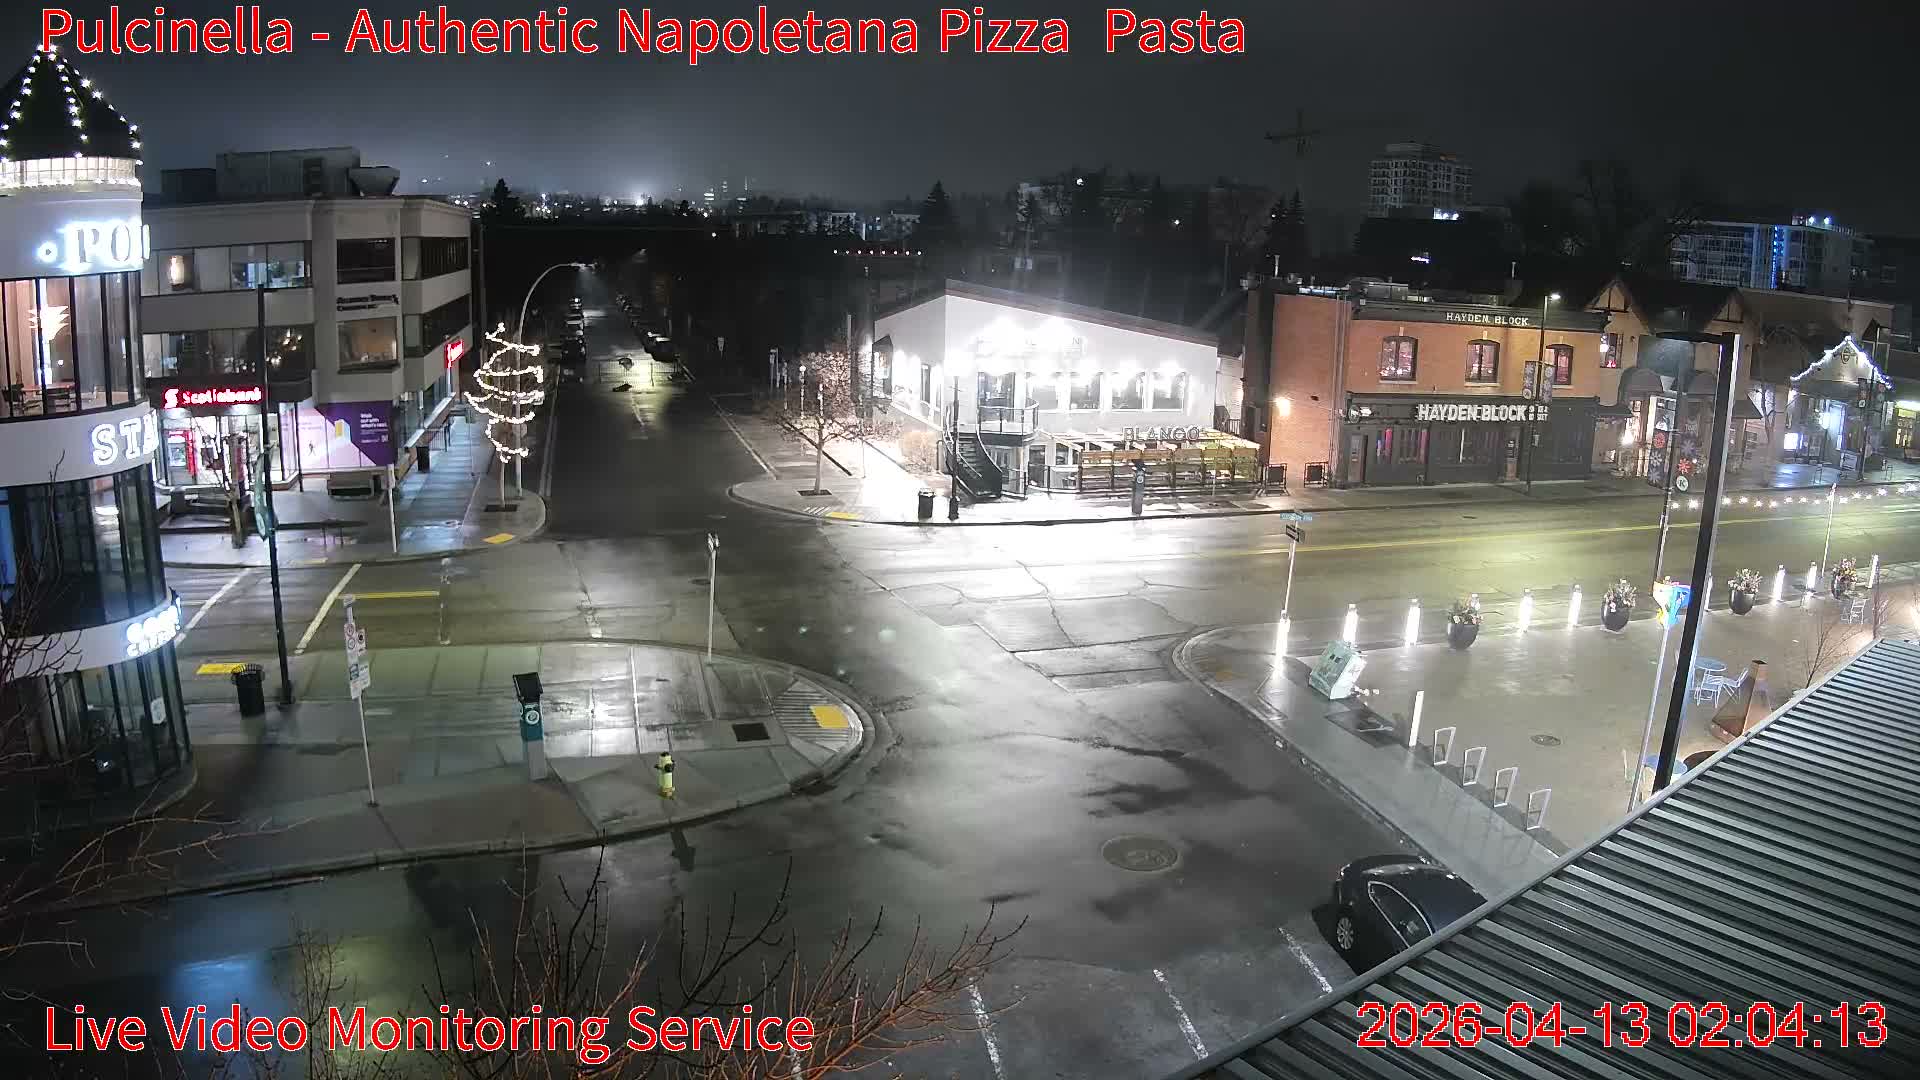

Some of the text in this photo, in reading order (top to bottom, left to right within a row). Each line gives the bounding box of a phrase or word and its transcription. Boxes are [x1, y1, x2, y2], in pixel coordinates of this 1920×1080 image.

[1494, 315, 1529, 326] BLOCK
[1416, 403, 1479, 421] HAYDEN
[1480, 404, 1527, 421] BLOCK
